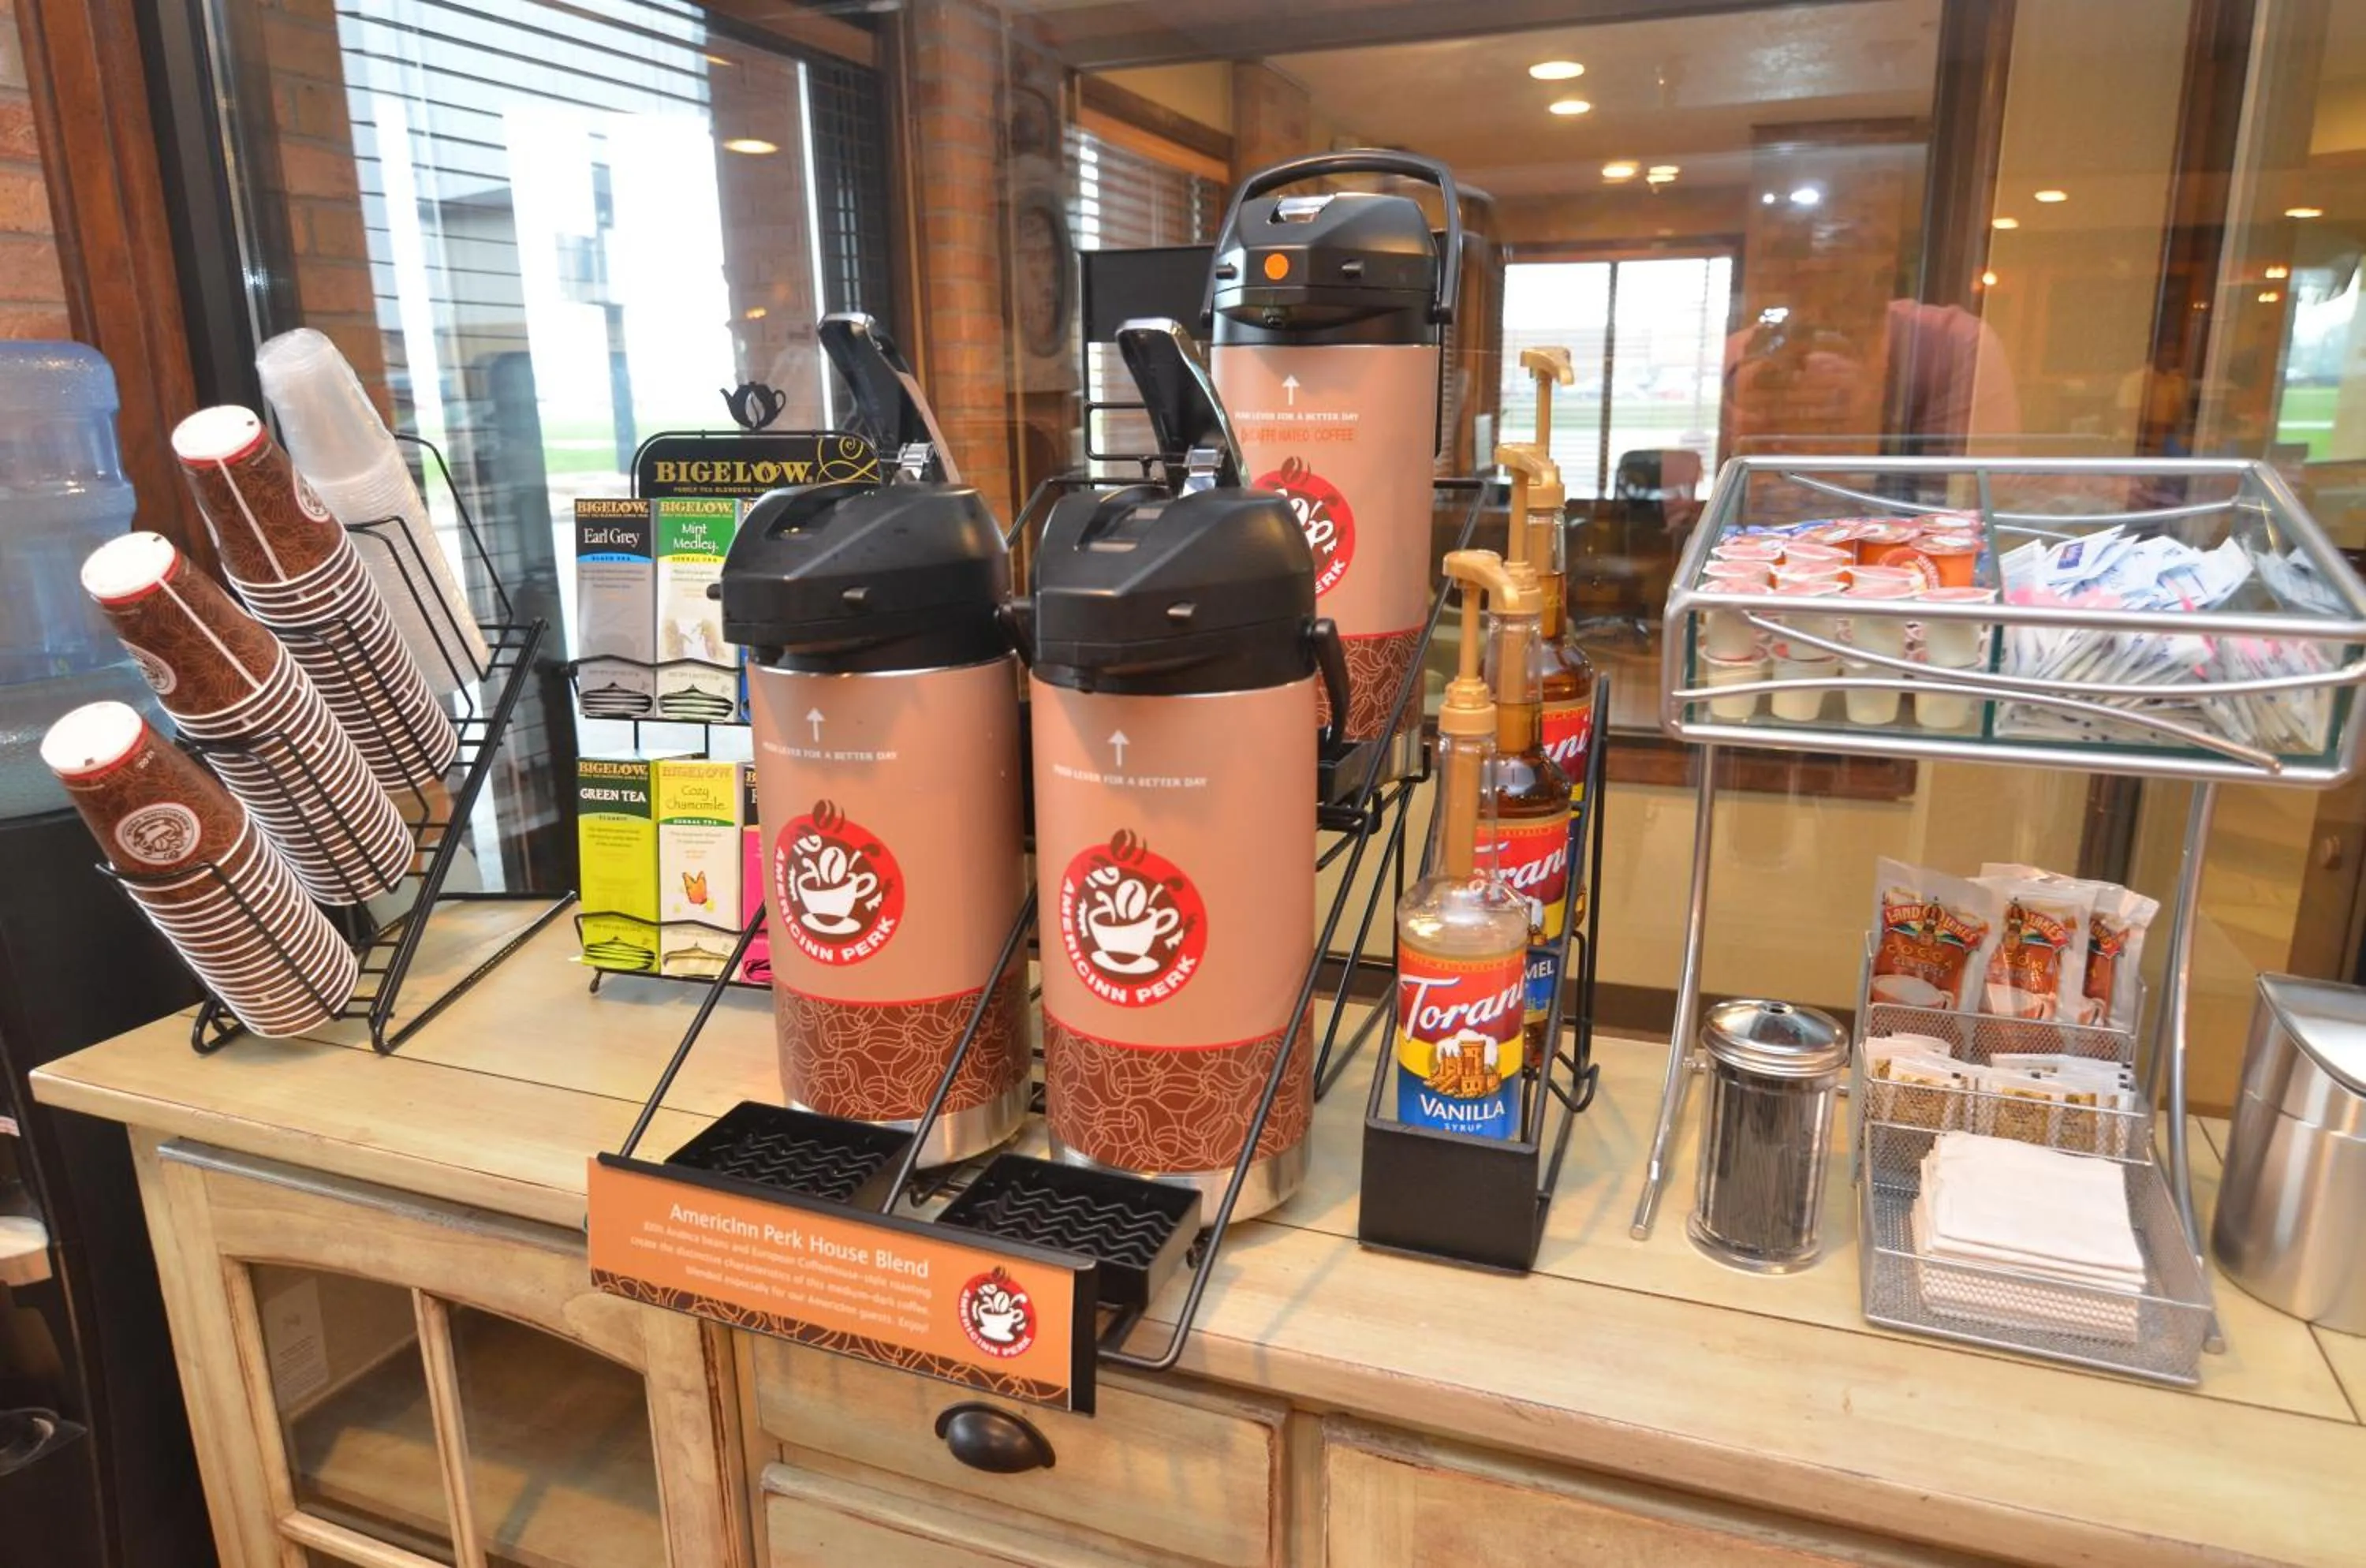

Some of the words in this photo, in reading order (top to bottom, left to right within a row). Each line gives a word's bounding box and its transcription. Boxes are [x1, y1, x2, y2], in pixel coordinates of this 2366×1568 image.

[1315, 427, 1354, 442] COFFEE
[654, 460, 812, 483] BIGELOW
[577, 501, 649, 513] BIGELOW
[659, 501, 733, 513] BIGELOW
[682, 521, 707, 535] Mint
[584, 527, 609, 543] Earl
[610, 527, 640, 547] Grey
[1315, 558, 1346, 594] ERK
[579, 760, 648, 775] BIGELOW
[1184, 778, 1207, 787] DAY
[580, 788, 619, 801] GREEN
[621, 790, 647, 803] TEA
[681, 785, 710, 801] Cozy
[774, 847, 834, 962] AMERICINN
[842, 916, 896, 961] PERK
[1886, 907, 1920, 924] LAND
[1062, 877, 1127, 1003] AMERICINN
[1136, 954, 1196, 1003] PERK
[1420, 1094, 1506, 1121] VANILLA
[1444, 1122, 1483, 1133] SYRUP
[670, 1203, 759, 1239] AmericInn
[763, 1223, 803, 1249] Perk
[809, 1234, 868, 1264] House
[875, 1249, 929, 1279] Blend
[793, 1274, 805, 1285] of
[806, 1275, 825, 1291] this
